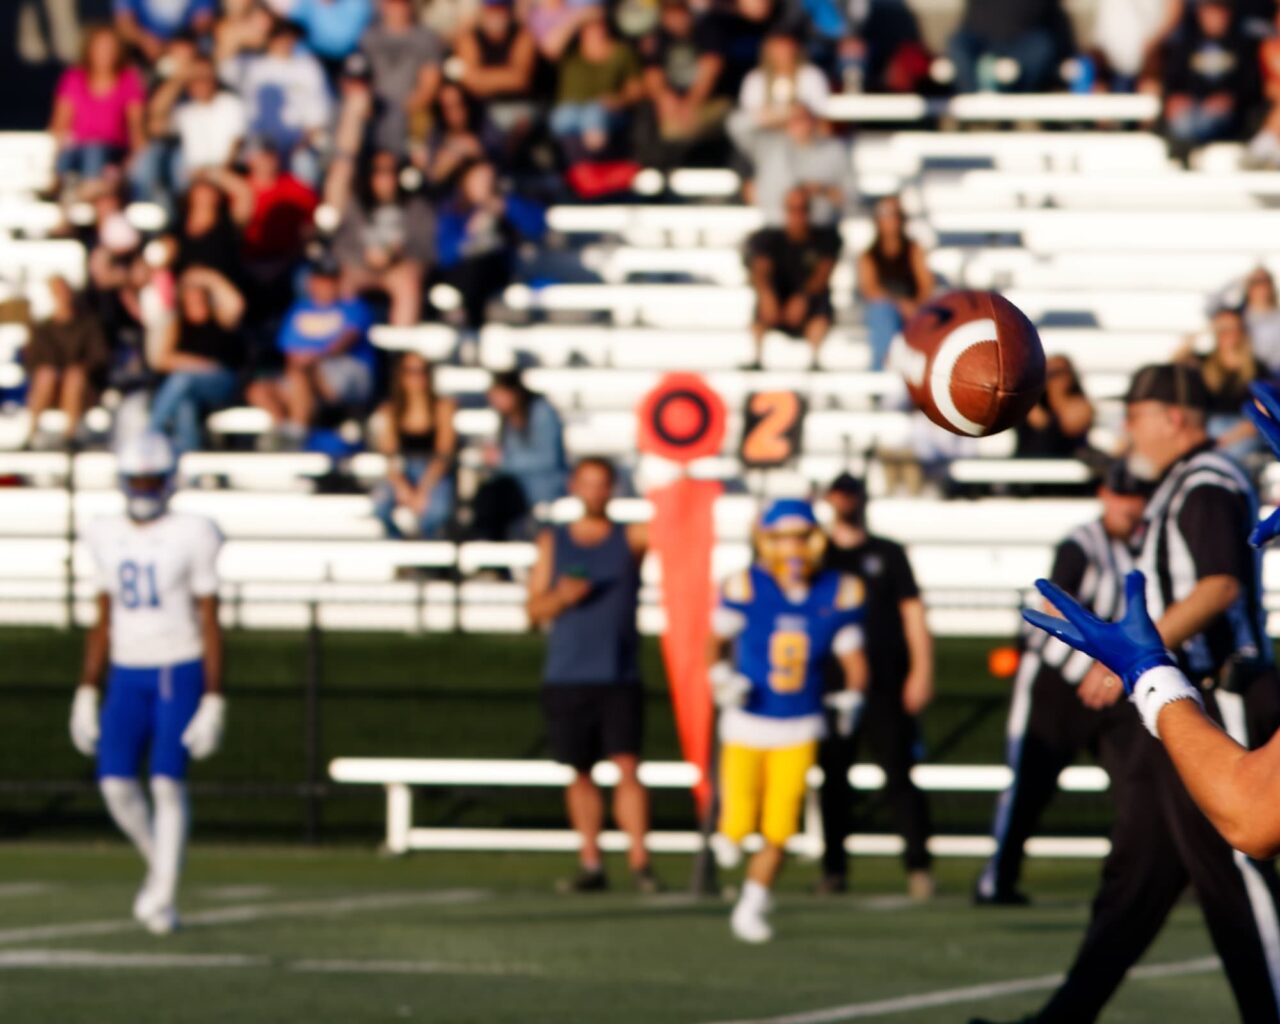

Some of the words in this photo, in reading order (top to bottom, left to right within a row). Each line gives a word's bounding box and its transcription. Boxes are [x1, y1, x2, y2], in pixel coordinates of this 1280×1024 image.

[743, 391, 798, 462] 2
[118, 558, 161, 609] 81
[770, 630, 809, 693] 9
